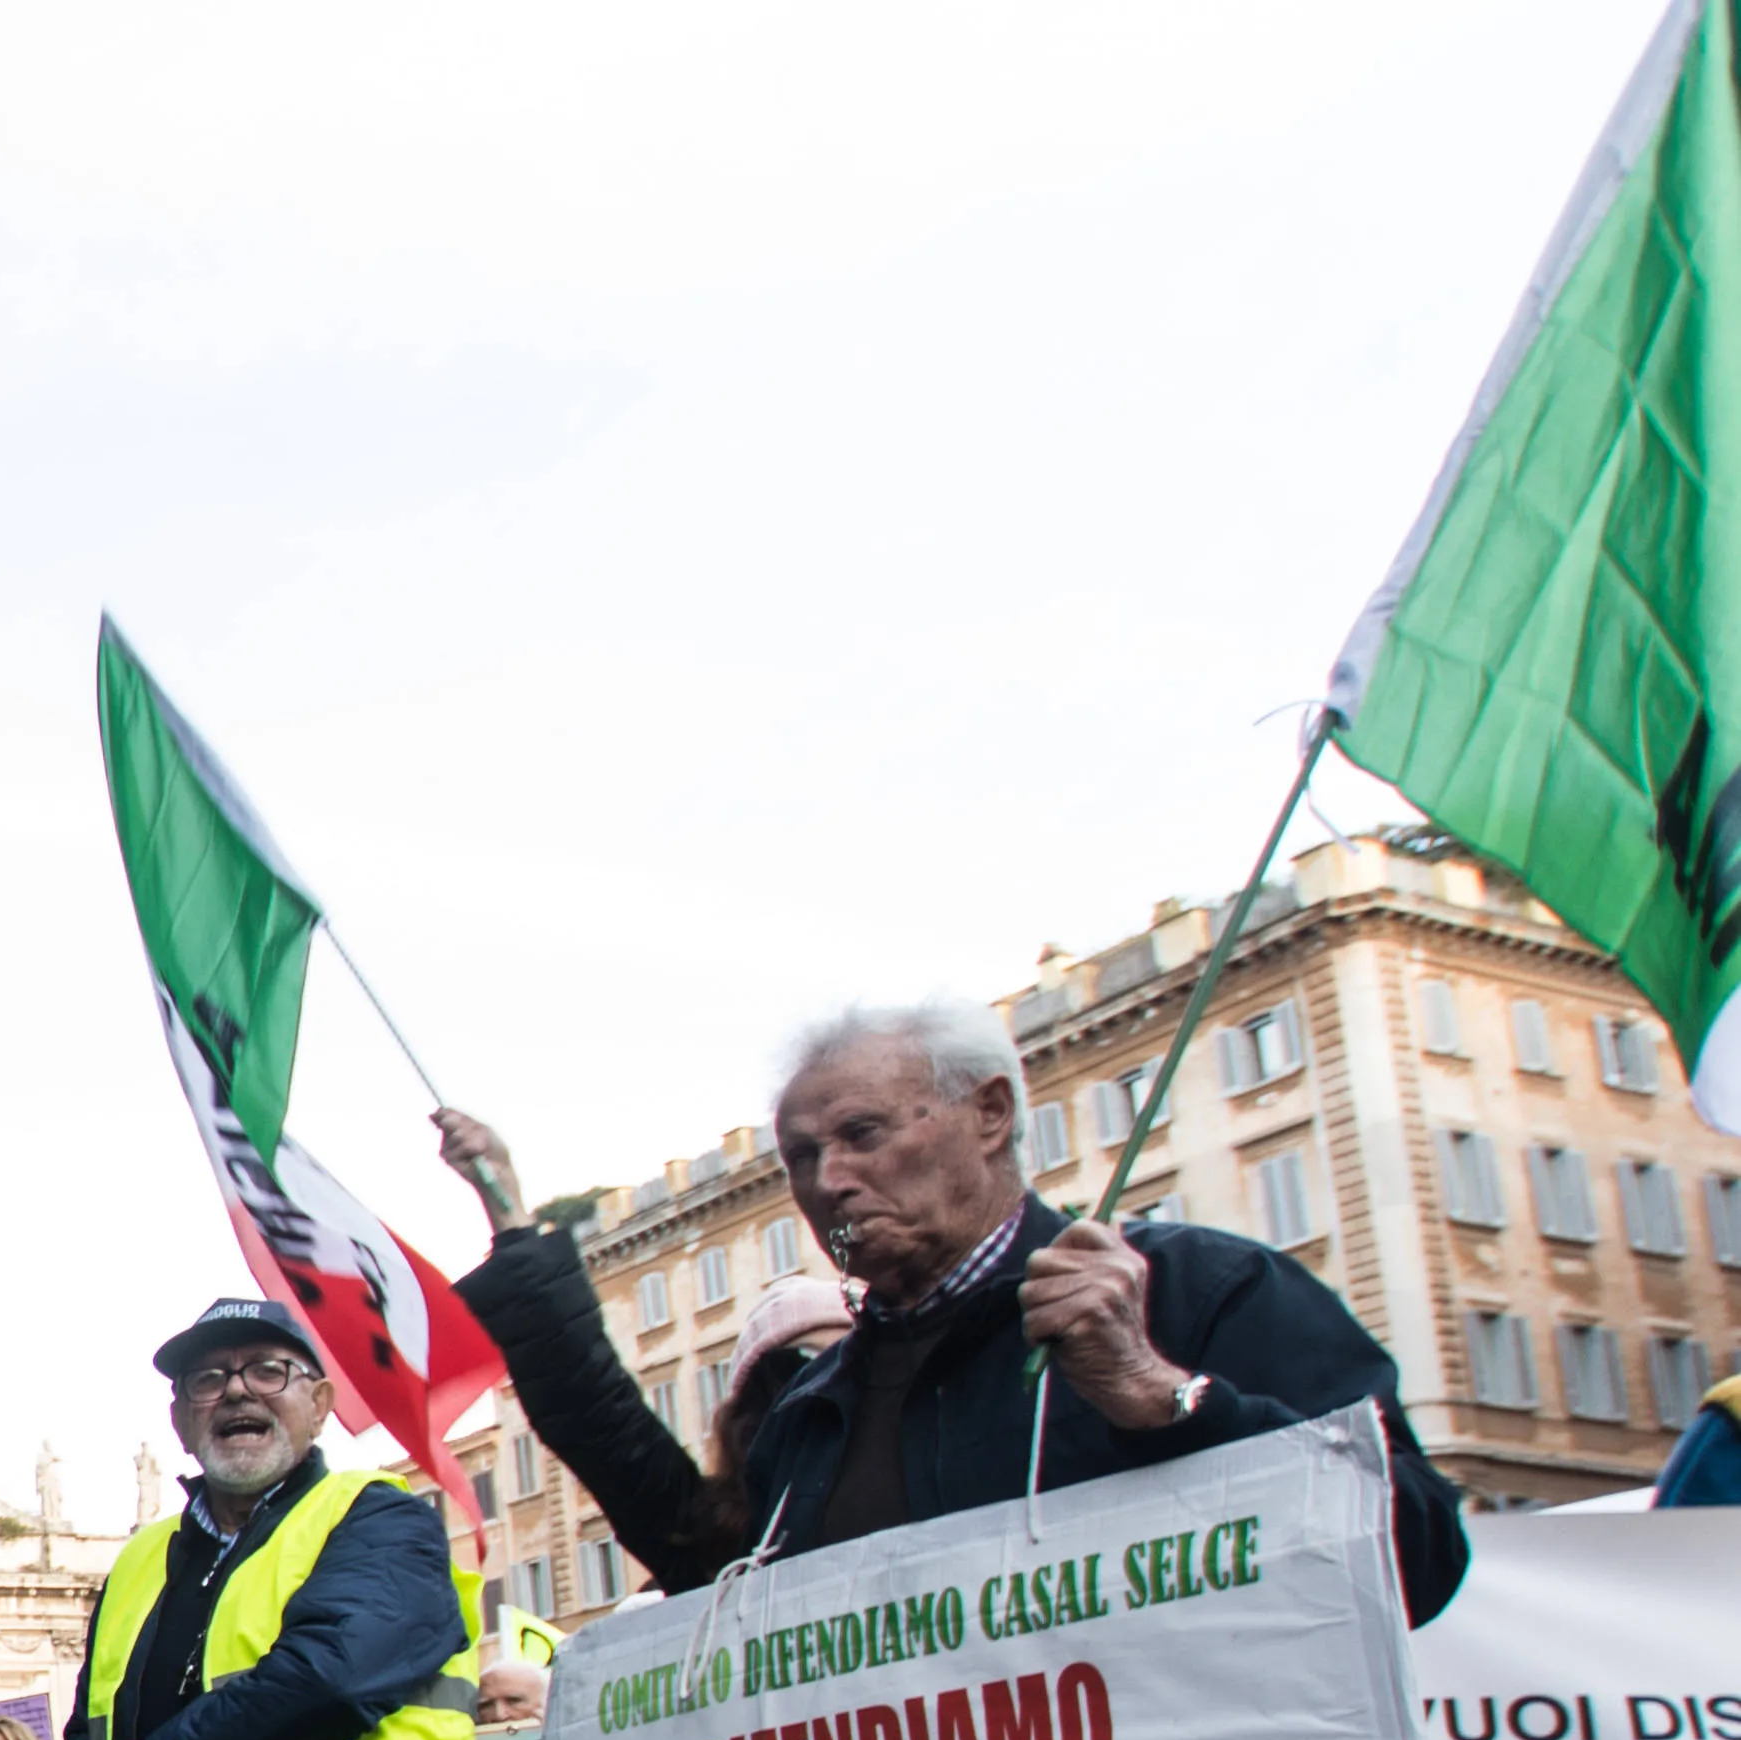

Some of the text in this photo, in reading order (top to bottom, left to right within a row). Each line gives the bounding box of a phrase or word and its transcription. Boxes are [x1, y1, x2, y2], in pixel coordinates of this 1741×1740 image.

[743, 1586, 964, 1698] DIFENDIAMO
[979, 1553, 1109, 1641] CASAL
[1123, 1515, 1261, 1611] SELCE
